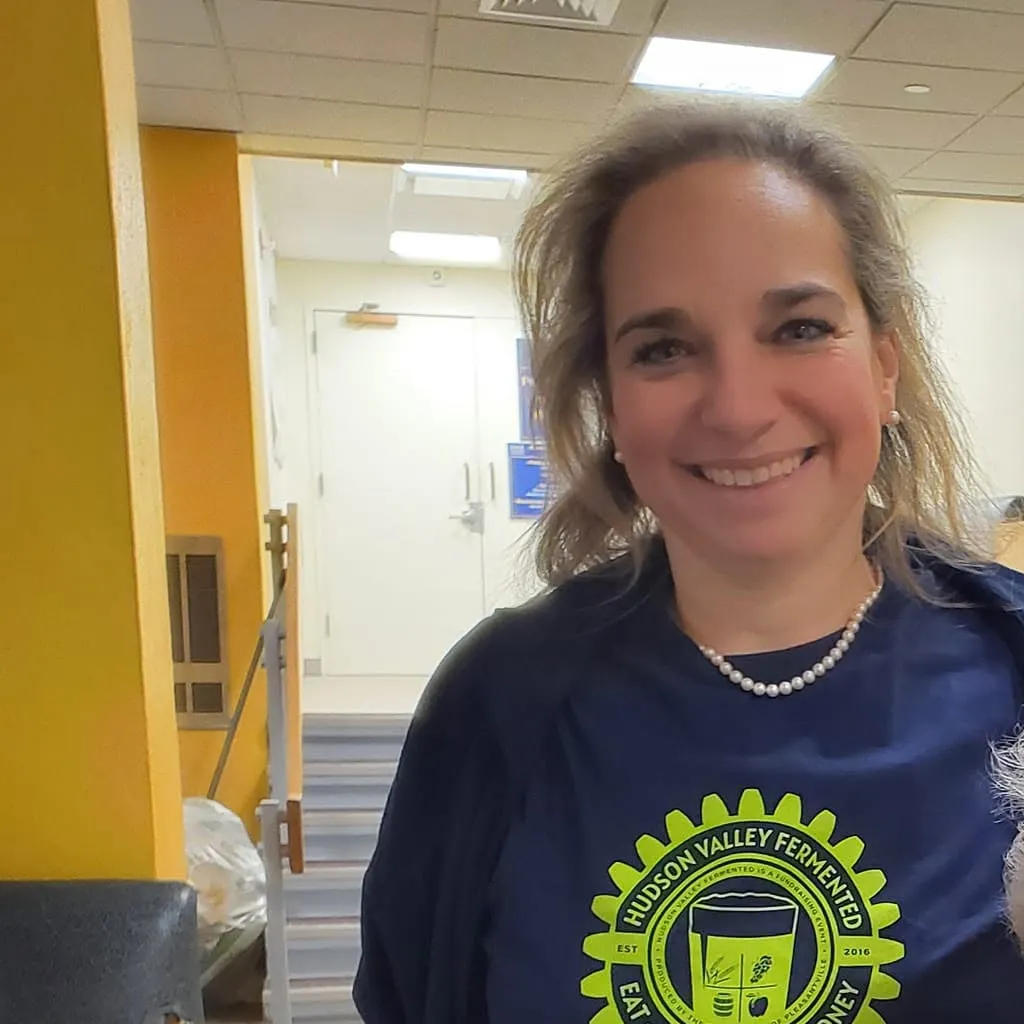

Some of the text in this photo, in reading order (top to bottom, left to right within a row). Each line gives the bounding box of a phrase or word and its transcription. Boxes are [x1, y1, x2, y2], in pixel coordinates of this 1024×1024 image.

[623, 828, 863, 930] HUDSON VALLEY FERMENTED
[656, 909, 677, 943] HUDSON
[676, 883, 701, 908] VALLEY
[704, 866, 755, 883] FERMENTED
[757, 867, 767, 875] IS
[775, 872, 819, 916] FUNDRAISING
[815, 917, 827, 945] EVENT
[617, 944, 637, 953] EST
[843, 947, 871, 956] 2016
[620, 982, 651, 1018] EAT
[656, 958, 677, 1004] PRODUCED
[676, 1006, 687, 1015] BY
[784, 959, 827, 1020] PLEASANTVILLE
